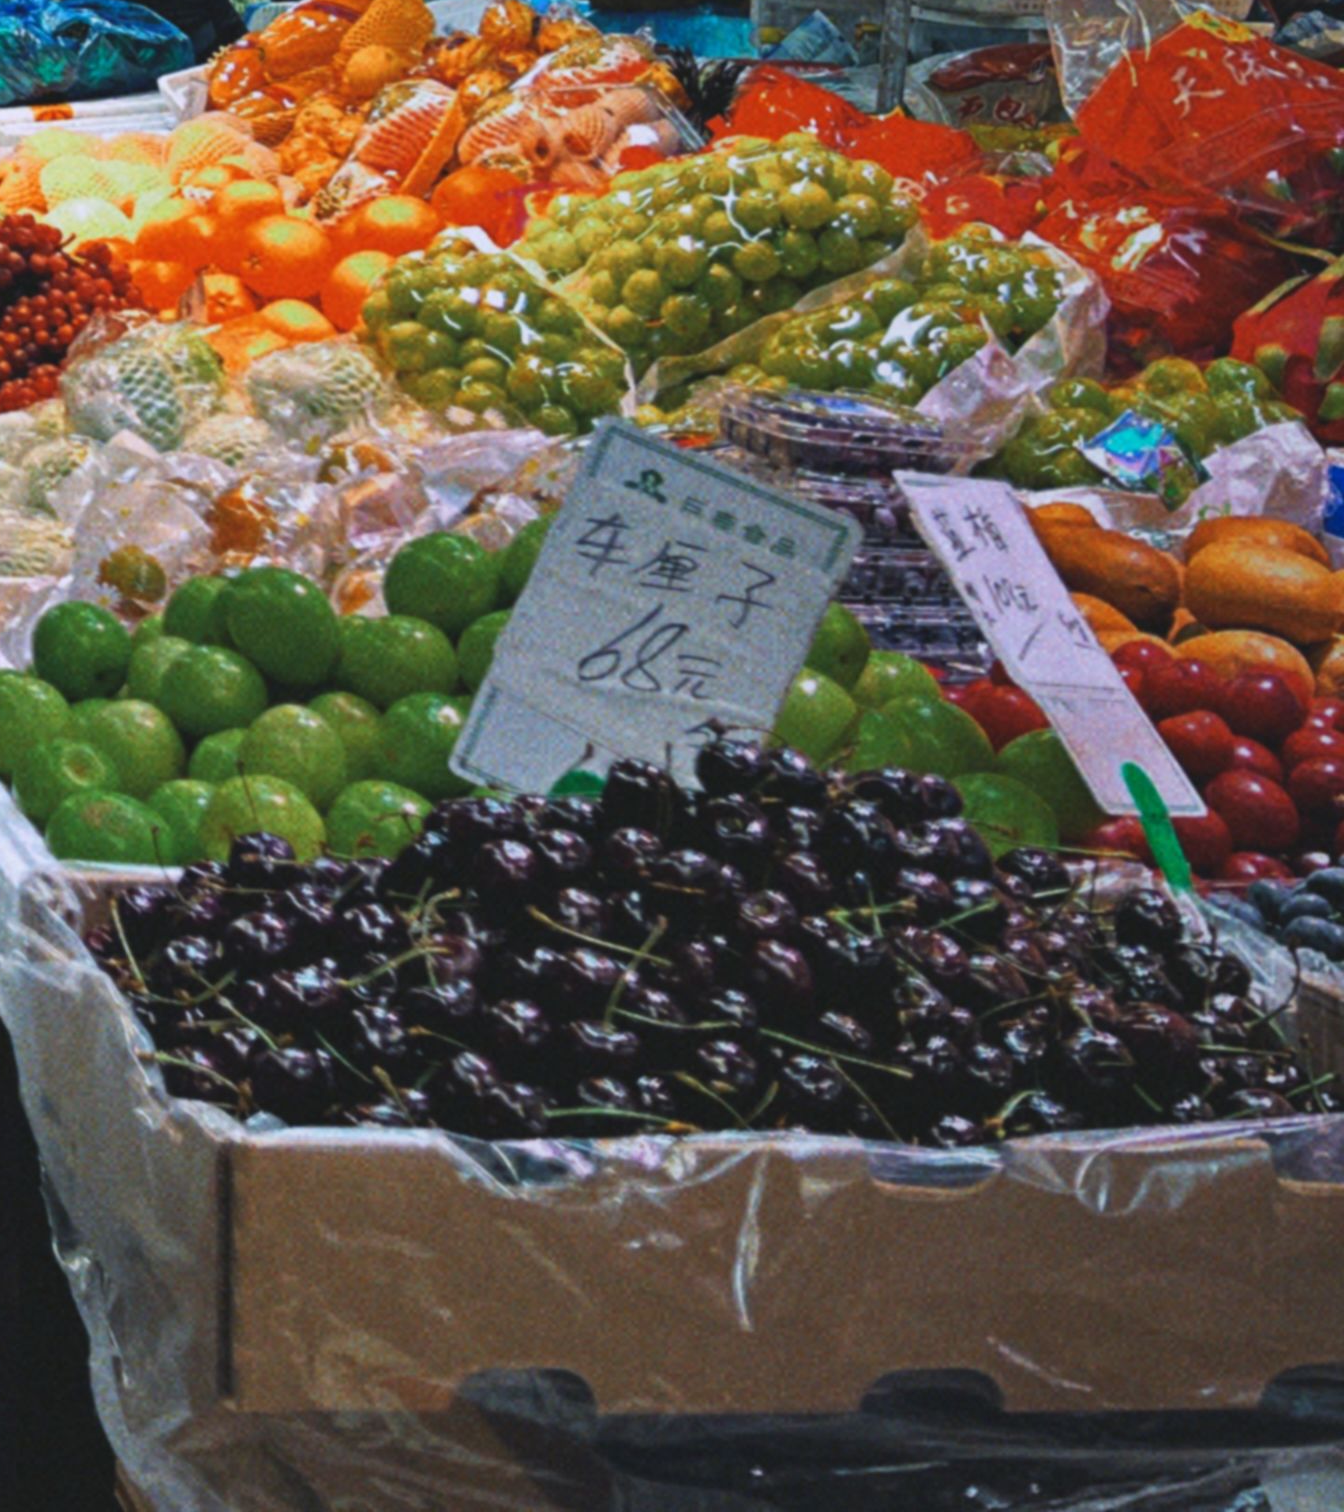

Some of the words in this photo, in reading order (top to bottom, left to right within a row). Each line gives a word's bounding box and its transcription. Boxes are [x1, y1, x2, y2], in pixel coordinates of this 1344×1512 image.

[576, 513, 776, 630] 车厘子
[577, 602, 723, 701] 68元
